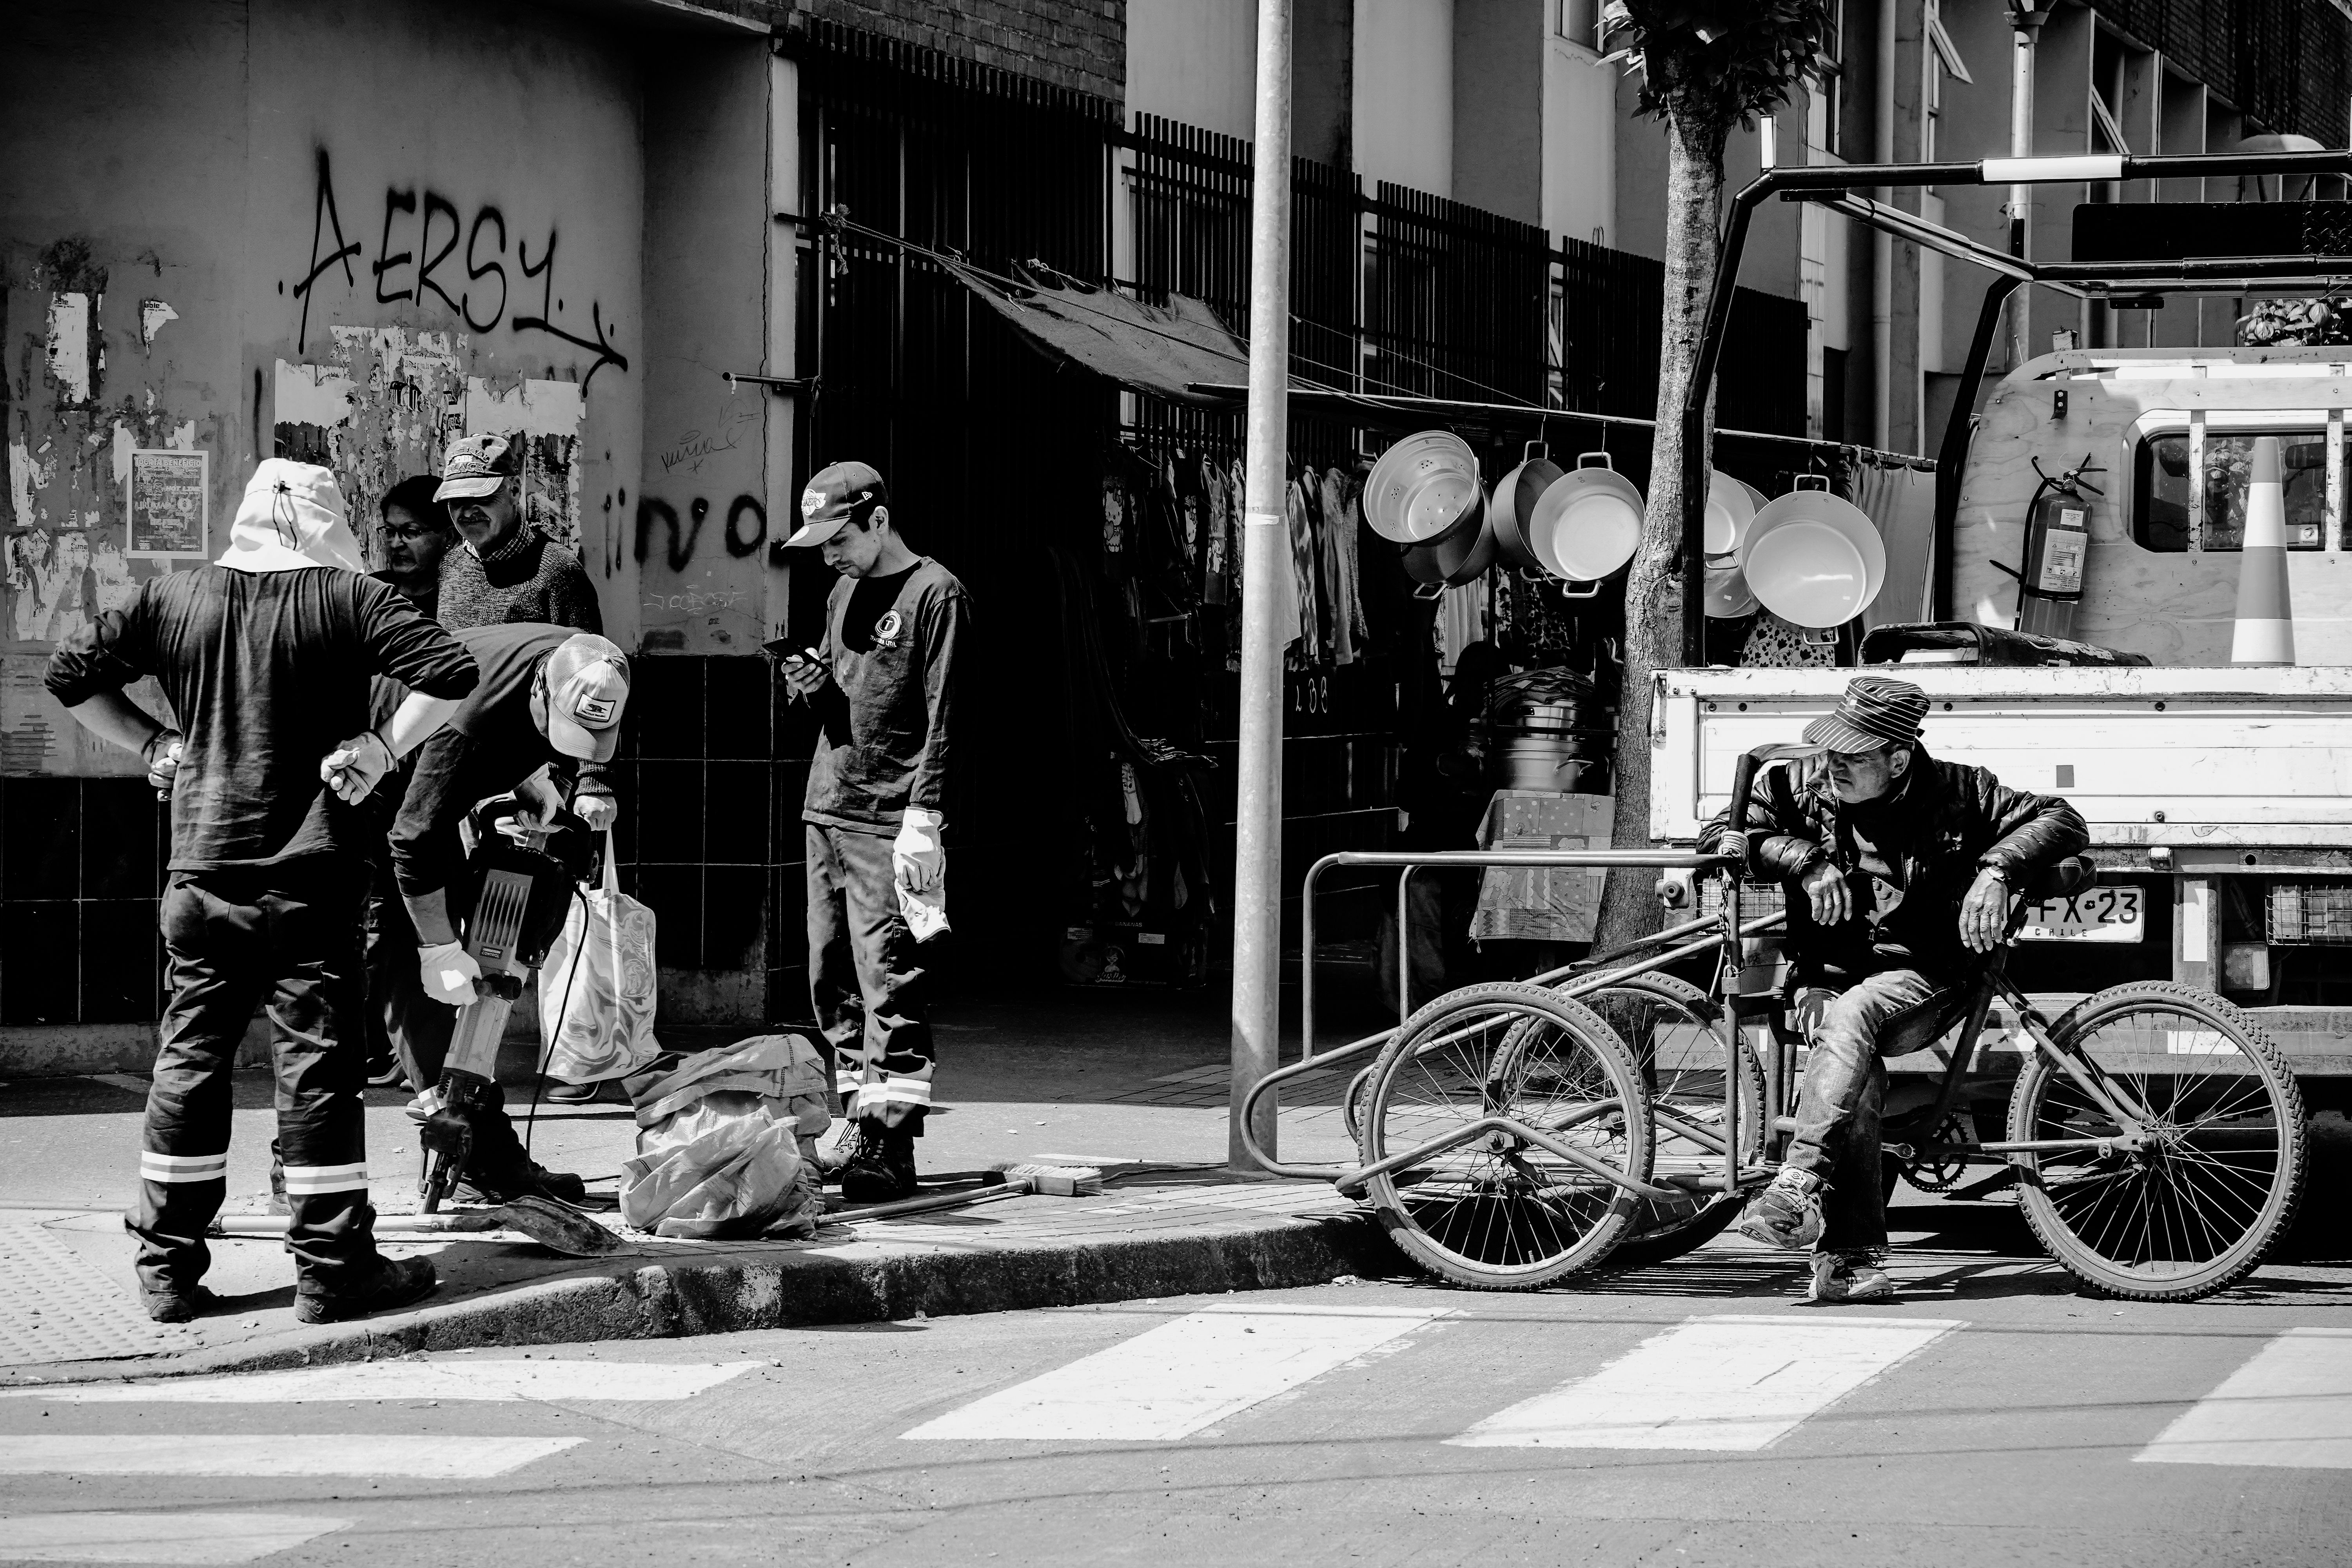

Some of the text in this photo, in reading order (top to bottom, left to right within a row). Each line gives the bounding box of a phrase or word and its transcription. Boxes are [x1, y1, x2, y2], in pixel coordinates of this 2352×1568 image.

[134, 456, 202, 468] TOCATA BENEFICIO
[2035, 928, 2087, 937] CHILE
